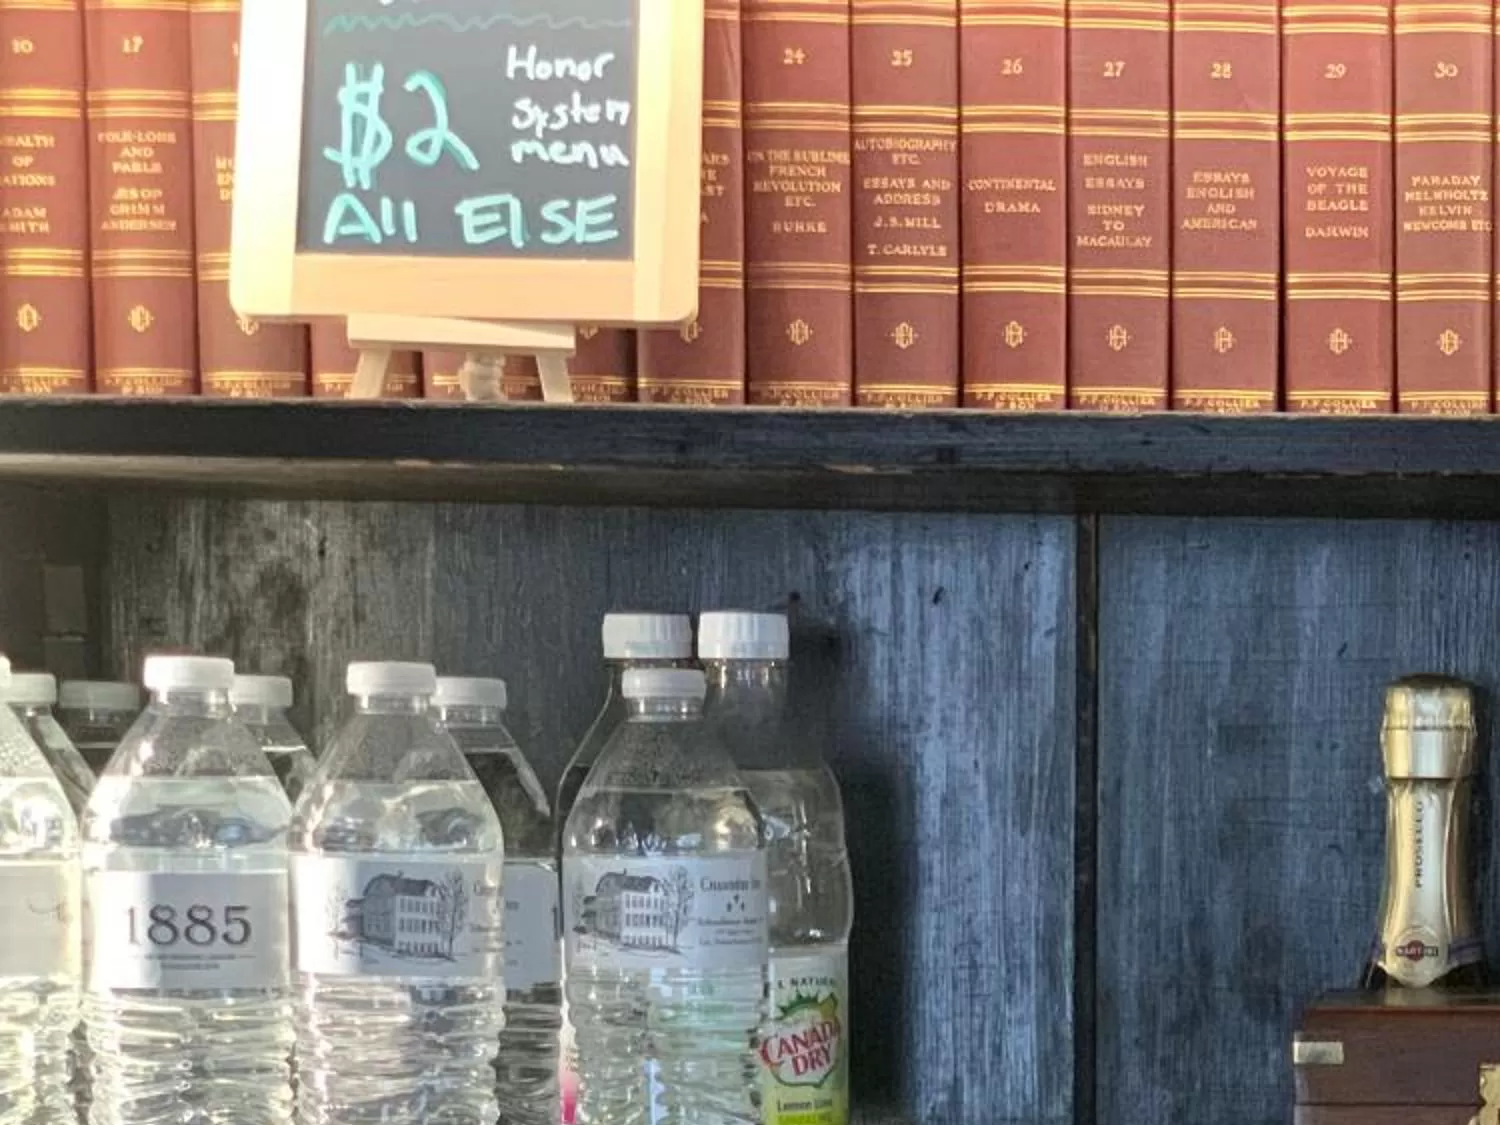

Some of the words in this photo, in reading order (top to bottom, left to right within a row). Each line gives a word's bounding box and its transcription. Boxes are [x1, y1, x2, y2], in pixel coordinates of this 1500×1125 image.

[122, 35, 144, 53] 17
[506, 44, 614, 82] Honor
[783, 48, 806, 65] 24
[891, 50, 913, 67] 25
[1001, 58, 1024, 75] 26
[1103, 61, 1125, 78] 27
[1210, 62, 1232, 79] 28
[1323, 63, 1347, 79] 29
[1433, 62, 1458, 78] 30
[511, 90, 631, 138] System
[323, 61, 480, 190] $2
[854, 138, 956, 151] AUTOBIOGRAPHY
[119, 147, 154, 158] AND
[510, 138, 630, 169] menu
[12, 156, 34, 167] OF
[1083, 153, 1148, 167] ENGLISH
[768, 165, 827, 177] FRENCH
[1192, 172, 1250, 183] ESSAYS
[1307, 166, 1368, 179] VOYAGE
[753, 181, 841, 193] REVOLUTION
[863, 177, 915, 190] ESSAYS
[922, 179, 951, 190] AND
[968, 179, 1056, 191] CONTINENTAL
[1084, 177, 1145, 190] ESSAYS
[1411, 175, 1481, 187] FARADAY
[1185, 188, 1255, 200] ENGLISH
[1307, 183, 1327, 195] OF
[1335, 183, 1368, 195] THE
[784, 195, 816, 208] ETC.
[873, 194, 940, 205] ADDRESS
[1307, 200, 1368, 211] BEAGLE
[984, 202, 1041, 213] DRAMA
[1087, 205, 1145, 217] SIDNEY
[1206, 203, 1236, 214] AND
[1418, 205, 1472, 216] KELVIN
[1103, 220, 1125, 232] TO
[1181, 219, 1258, 230] AMERICAN
[1305, 226, 1368, 238] DARWIN
[1076, 236, 1151, 248] MACAULAY
[127, 904, 252, 945] 1885
[791, 1046, 833, 1077] DRY
